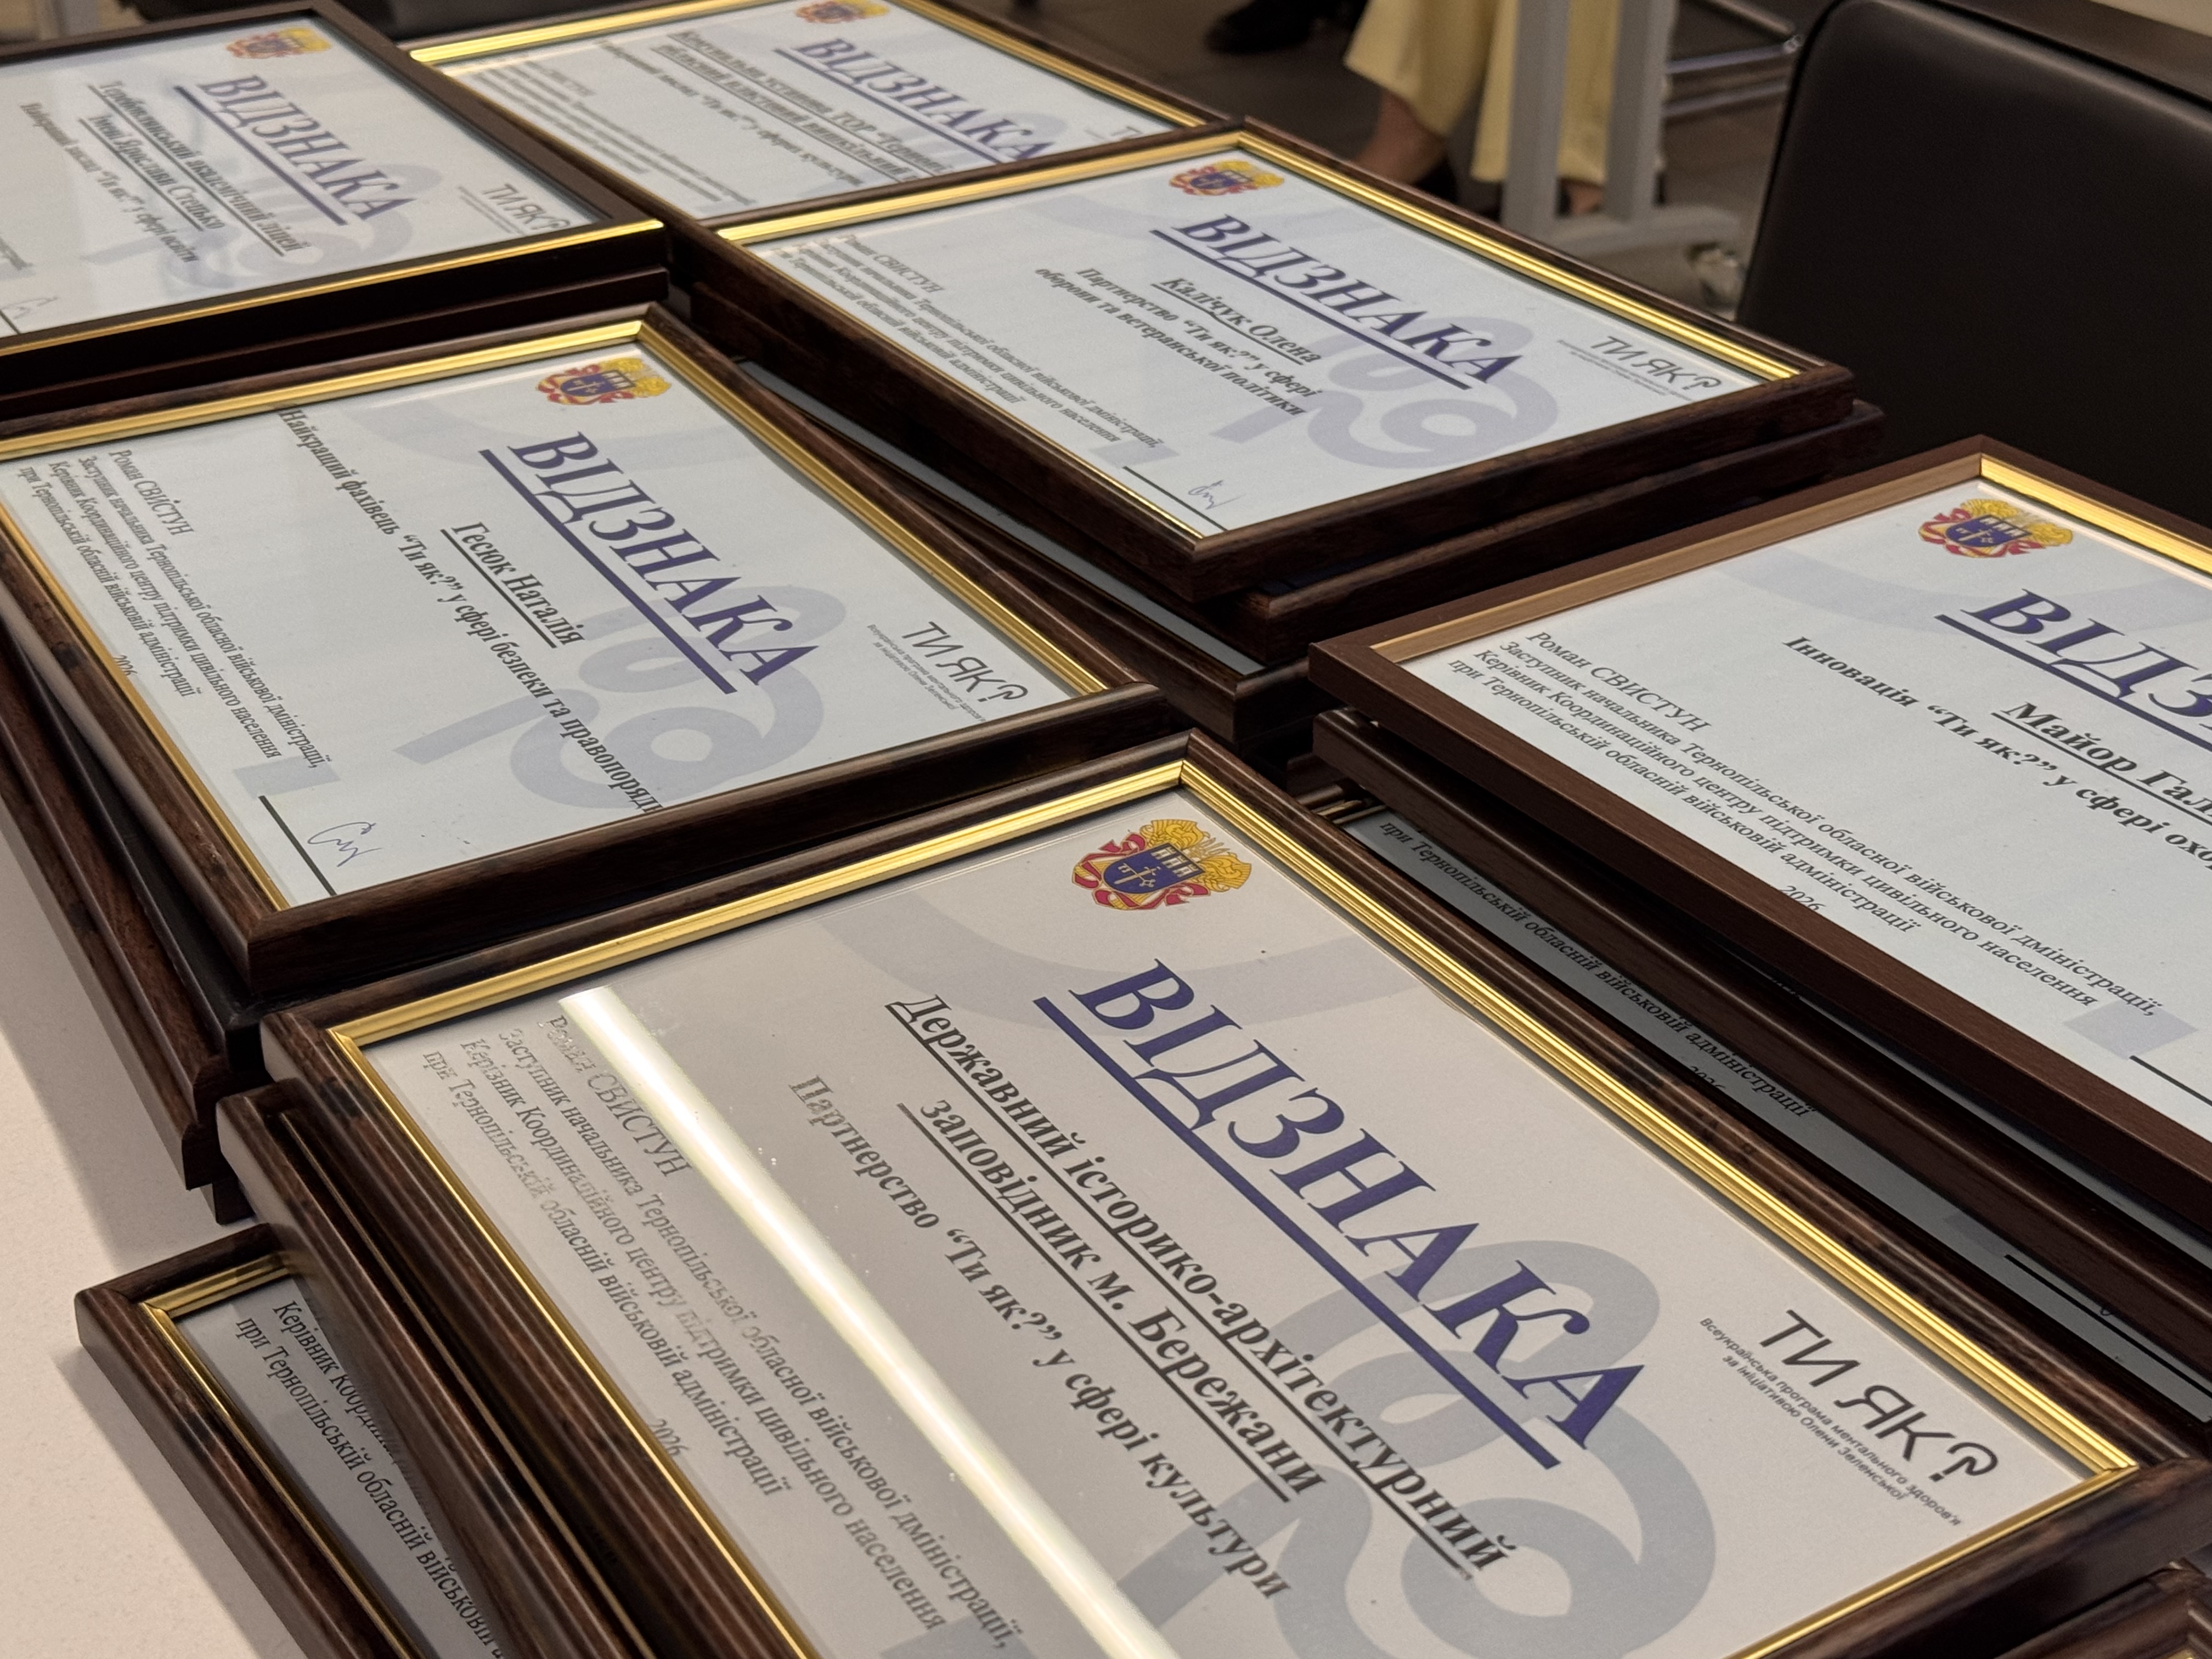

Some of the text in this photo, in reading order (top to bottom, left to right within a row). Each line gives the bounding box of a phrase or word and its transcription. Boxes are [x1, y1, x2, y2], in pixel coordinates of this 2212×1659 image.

[196, 74, 416, 221] ВІДЗНАКА
[795, 37, 1055, 161] ВІДЗНАКА
[483, 183, 528, 206] ТИ
[1035, 269, 1307, 416] оборони та ветеранської політики
[1075, 267, 1324, 398] Партнерство “Ти як?” у сфері
[1160, 278, 1322, 363] Калічук Олена
[1171, 213, 1523, 384] ВІДЗНАКА
[1590, 335, 1649, 362] ТИ
[107, 449, 195, 536] Роман СВИСТУН
[278, 409, 360, 480] Найкращий
[336, 480, 401, 535] фахівець
[17, 466, 204, 698] при Тернопільській обласній військовій адміністрації
[47, 460, 87, 499] Керівник
[128, 569, 166, 601] центру
[152, 601, 202, 653] підтримки
[188, 652, 242, 707] цивільного
[229, 706, 283, 759] населення
[77, 454, 120, 499] Заступник
[144, 543, 214, 612] Тернопільської
[195, 611, 245, 654] обласної
[226, 652, 284, 704] військової
[262, 703, 333, 769] дміністрації,
[397, 534, 428, 562] “Ти
[413, 562, 465, 591] як?”
[436, 592, 468, 603] у
[450, 521, 585, 646] Гесюк Наталія
[506, 431, 820, 686] ВІДЗНАКА
[453, 605, 510, 643] сфері
[489, 641, 555, 699] безпеки
[901, 620, 964, 658] ТИ
[1525, 631, 1712, 733] Роман СВИСТУН
[1959, 588, 2212, 731] ВІДЗ
[541, 698, 572, 719] та
[1781, 636, 1920, 708] Інновація
[1926, 704, 1979, 738] “Ти
[1973, 737, 2059, 771] як?”
[2041, 774, 2079, 787] у
[2075, 788, 2171, 834] сфері
[2000, 701, 2138, 772] Майор
[1447, 659, 1922, 933] при Тернопільській обласній військовій адміністрації
[1472, 649, 2100, 1007] Керівник Координаційного центру підтримки цивільного населення
[1499, 641, 2164, 1017] Заступник начальника Тернопільської обласної військової дміністрації,
[1379, 821, 1412, 845] при
[1409, 838, 1529, 924] Тернопільській
[1524, 919, 1599, 973] обласній
[1778, 884, 1827, 911] 2026
[586, 1066, 696, 1178] СВИСТУН
[1067, 958, 1645, 1451] ВІДЗНАКА
[273, 1300, 340, 1375] Керівник
[788, 1074, 1292, 1600] Партнерство “Ти як?” у сфері культури
[890, 994, 1517, 1572] Державний історико-архітектурний
[919, 1099, 1327, 1495] заповідник м. Бережани
[558, 1105, 645, 1197] начальника
[635, 1193, 758, 1325] Тернопільської
[740, 1325, 827, 1407] обласної
[805, 1406, 913, 1511] військової
[887, 1511, 1024, 1650] дміністрації,
[1758, 1308, 1862, 1389] ТИ
[234, 1316, 272, 1351] при
[267, 1345, 373, 1472] Тернопільській
[357, 1477, 433, 1551] обласній
[648, 1418, 690, 1456] 2026
[1699, 1317, 1963, 1527] Всеукраїнська програма ментального здоров'я
[1721, 1355, 1910, 1501] за ініціативою Олени Зеленської
